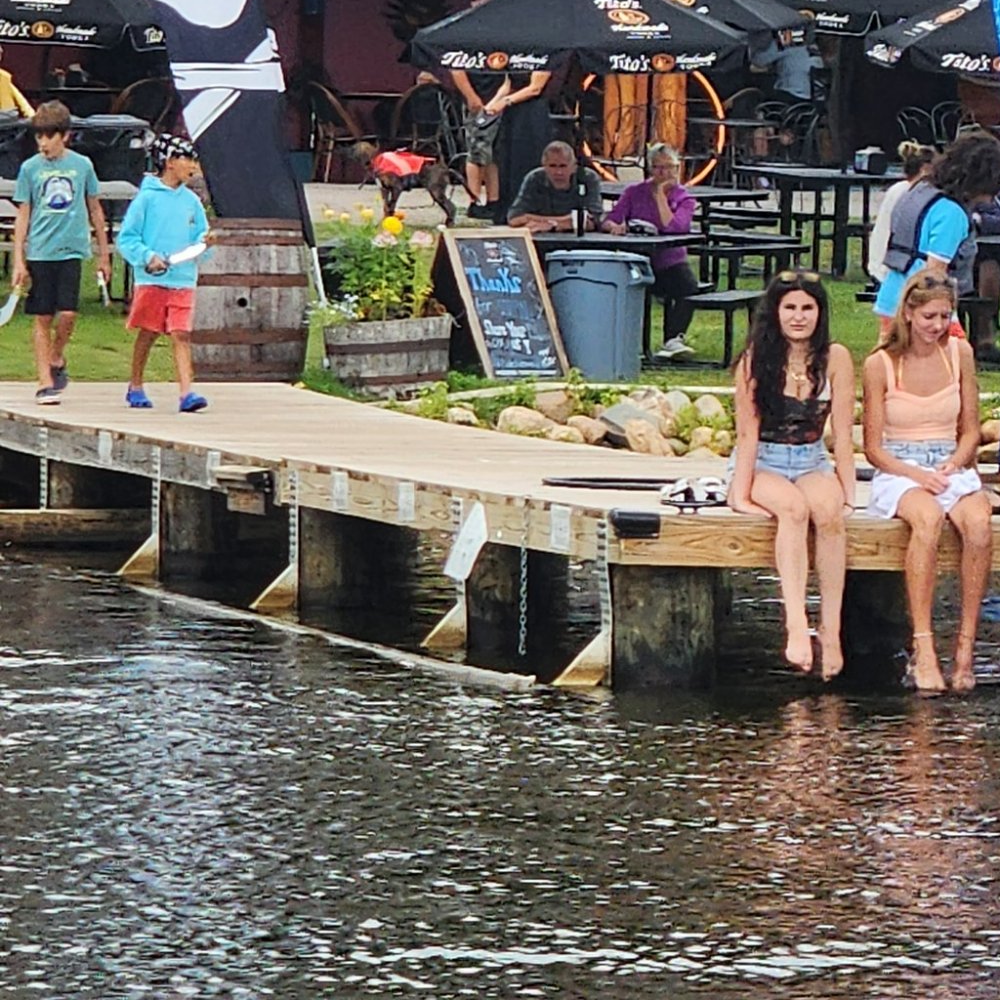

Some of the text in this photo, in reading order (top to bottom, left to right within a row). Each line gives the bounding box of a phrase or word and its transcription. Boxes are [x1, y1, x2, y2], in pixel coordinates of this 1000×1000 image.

[440, 50, 486, 69] Tito's
[609, 53, 652, 72] Tito's
[940, 52, 992, 72] Tito's
